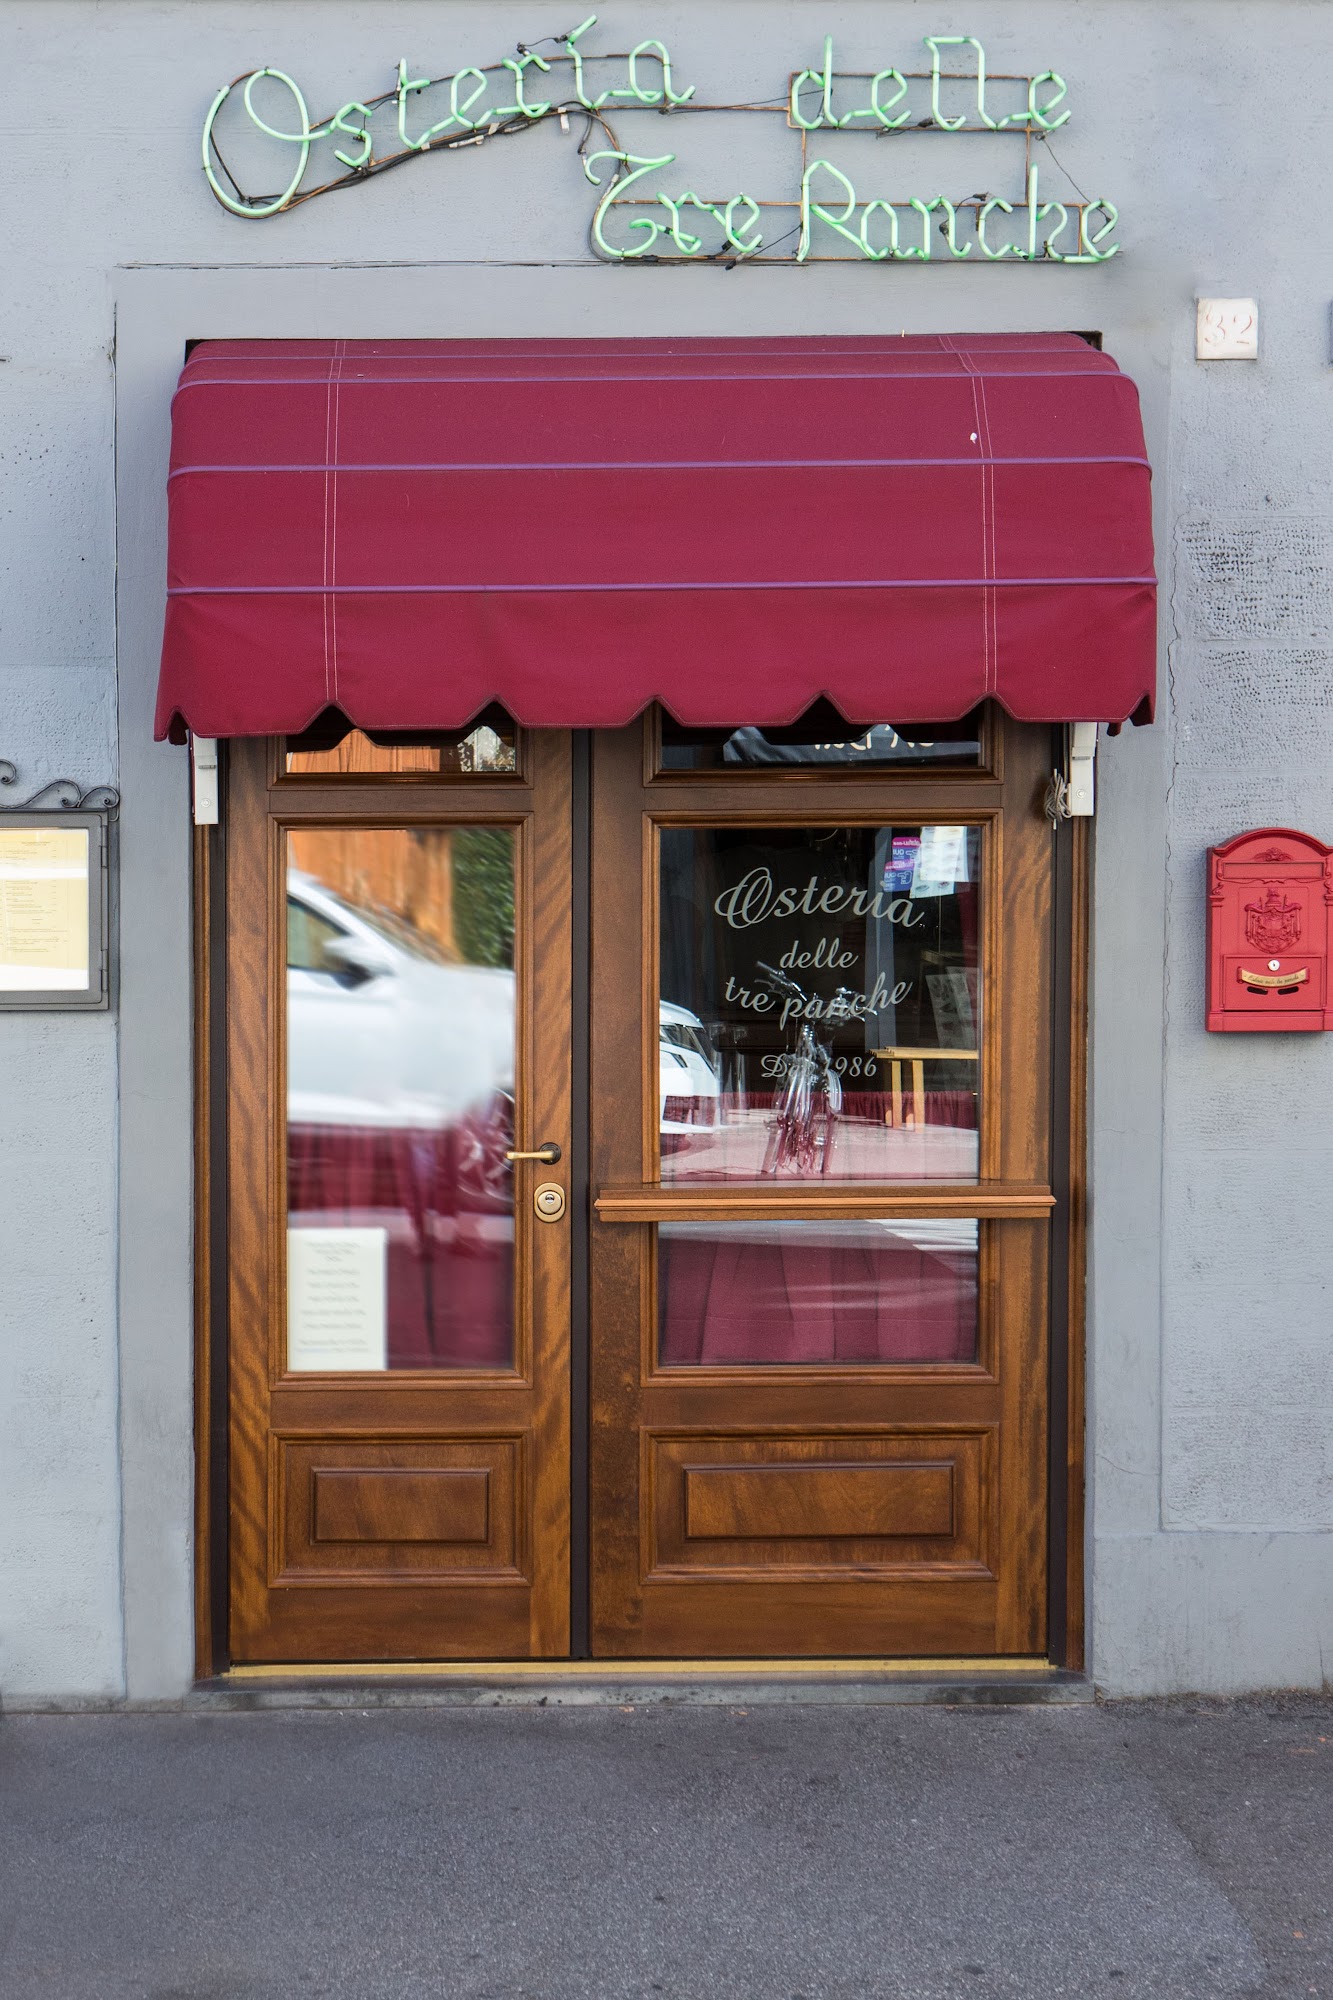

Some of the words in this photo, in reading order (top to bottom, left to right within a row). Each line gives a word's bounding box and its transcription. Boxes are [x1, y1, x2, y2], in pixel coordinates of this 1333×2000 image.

[203, 15, 696, 216] Osteria
[791, 33, 1071, 131] delle
[1204, 314, 1253, 345] 32
[714, 867, 924, 929] Osteria
[779, 937, 859, 969] delle
[724, 976, 776, 1013] tre
[779, 971, 913, 1031] panche
